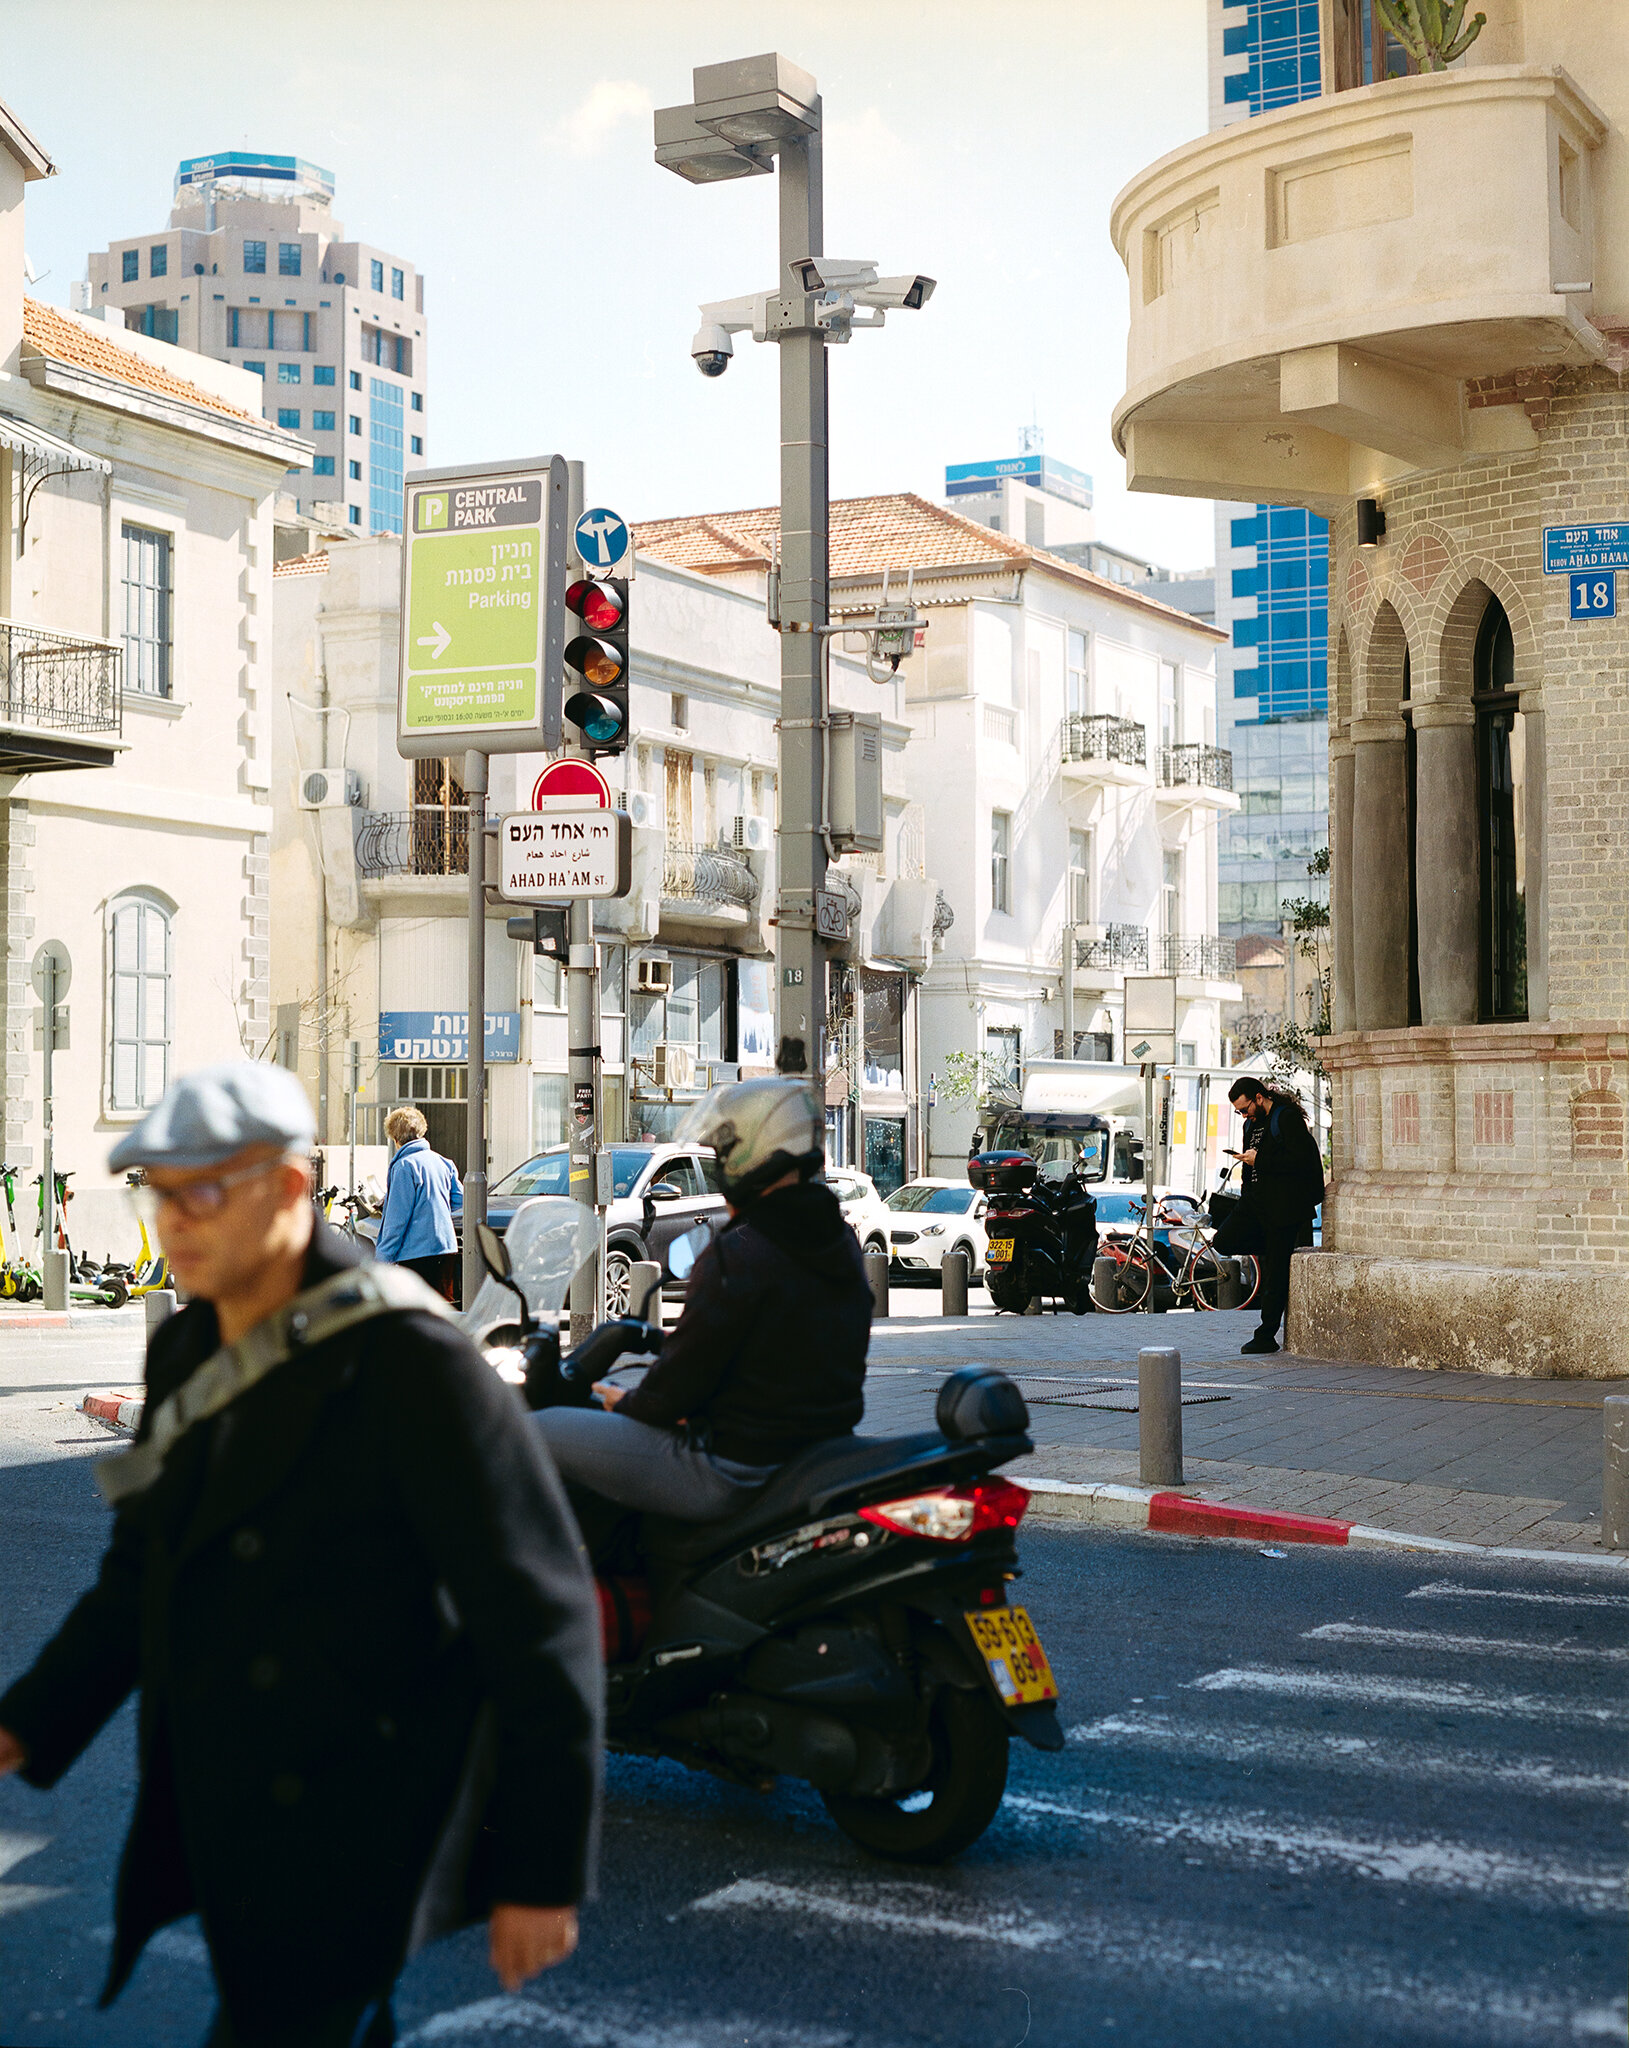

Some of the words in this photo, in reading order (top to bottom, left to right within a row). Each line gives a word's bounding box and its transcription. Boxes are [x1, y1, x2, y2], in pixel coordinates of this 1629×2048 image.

[455, 486, 527, 508] CENTRAL
[454, 507, 496, 526] PARK
[491, 542, 531, 565] חניון
[445, 568, 495, 586] פסגות
[501, 564, 531, 581] בית
[469, 590, 531, 609] Parking
[1576, 582, 1608, 609] 18
[420, 681, 465, 698] למחזיקי
[468, 682, 494, 692] חינם
[498, 679, 523, 691] חניה
[434, 695, 473, 709] דיסקונט
[476, 693, 505, 704] מפתח
[510, 824, 544, 841] העם
[551, 823, 584, 840] אחד
[572, 848, 590, 862] شارع
[510, 872, 545, 888] AHAD
[549, 870, 591, 887] HA'AM
[788, 969, 802, 983] 18
[432, 1014, 510, 1036] וילנות
[995, 1250, 1008, 1258] 001
[1011, 1652, 1038, 1683] 89
